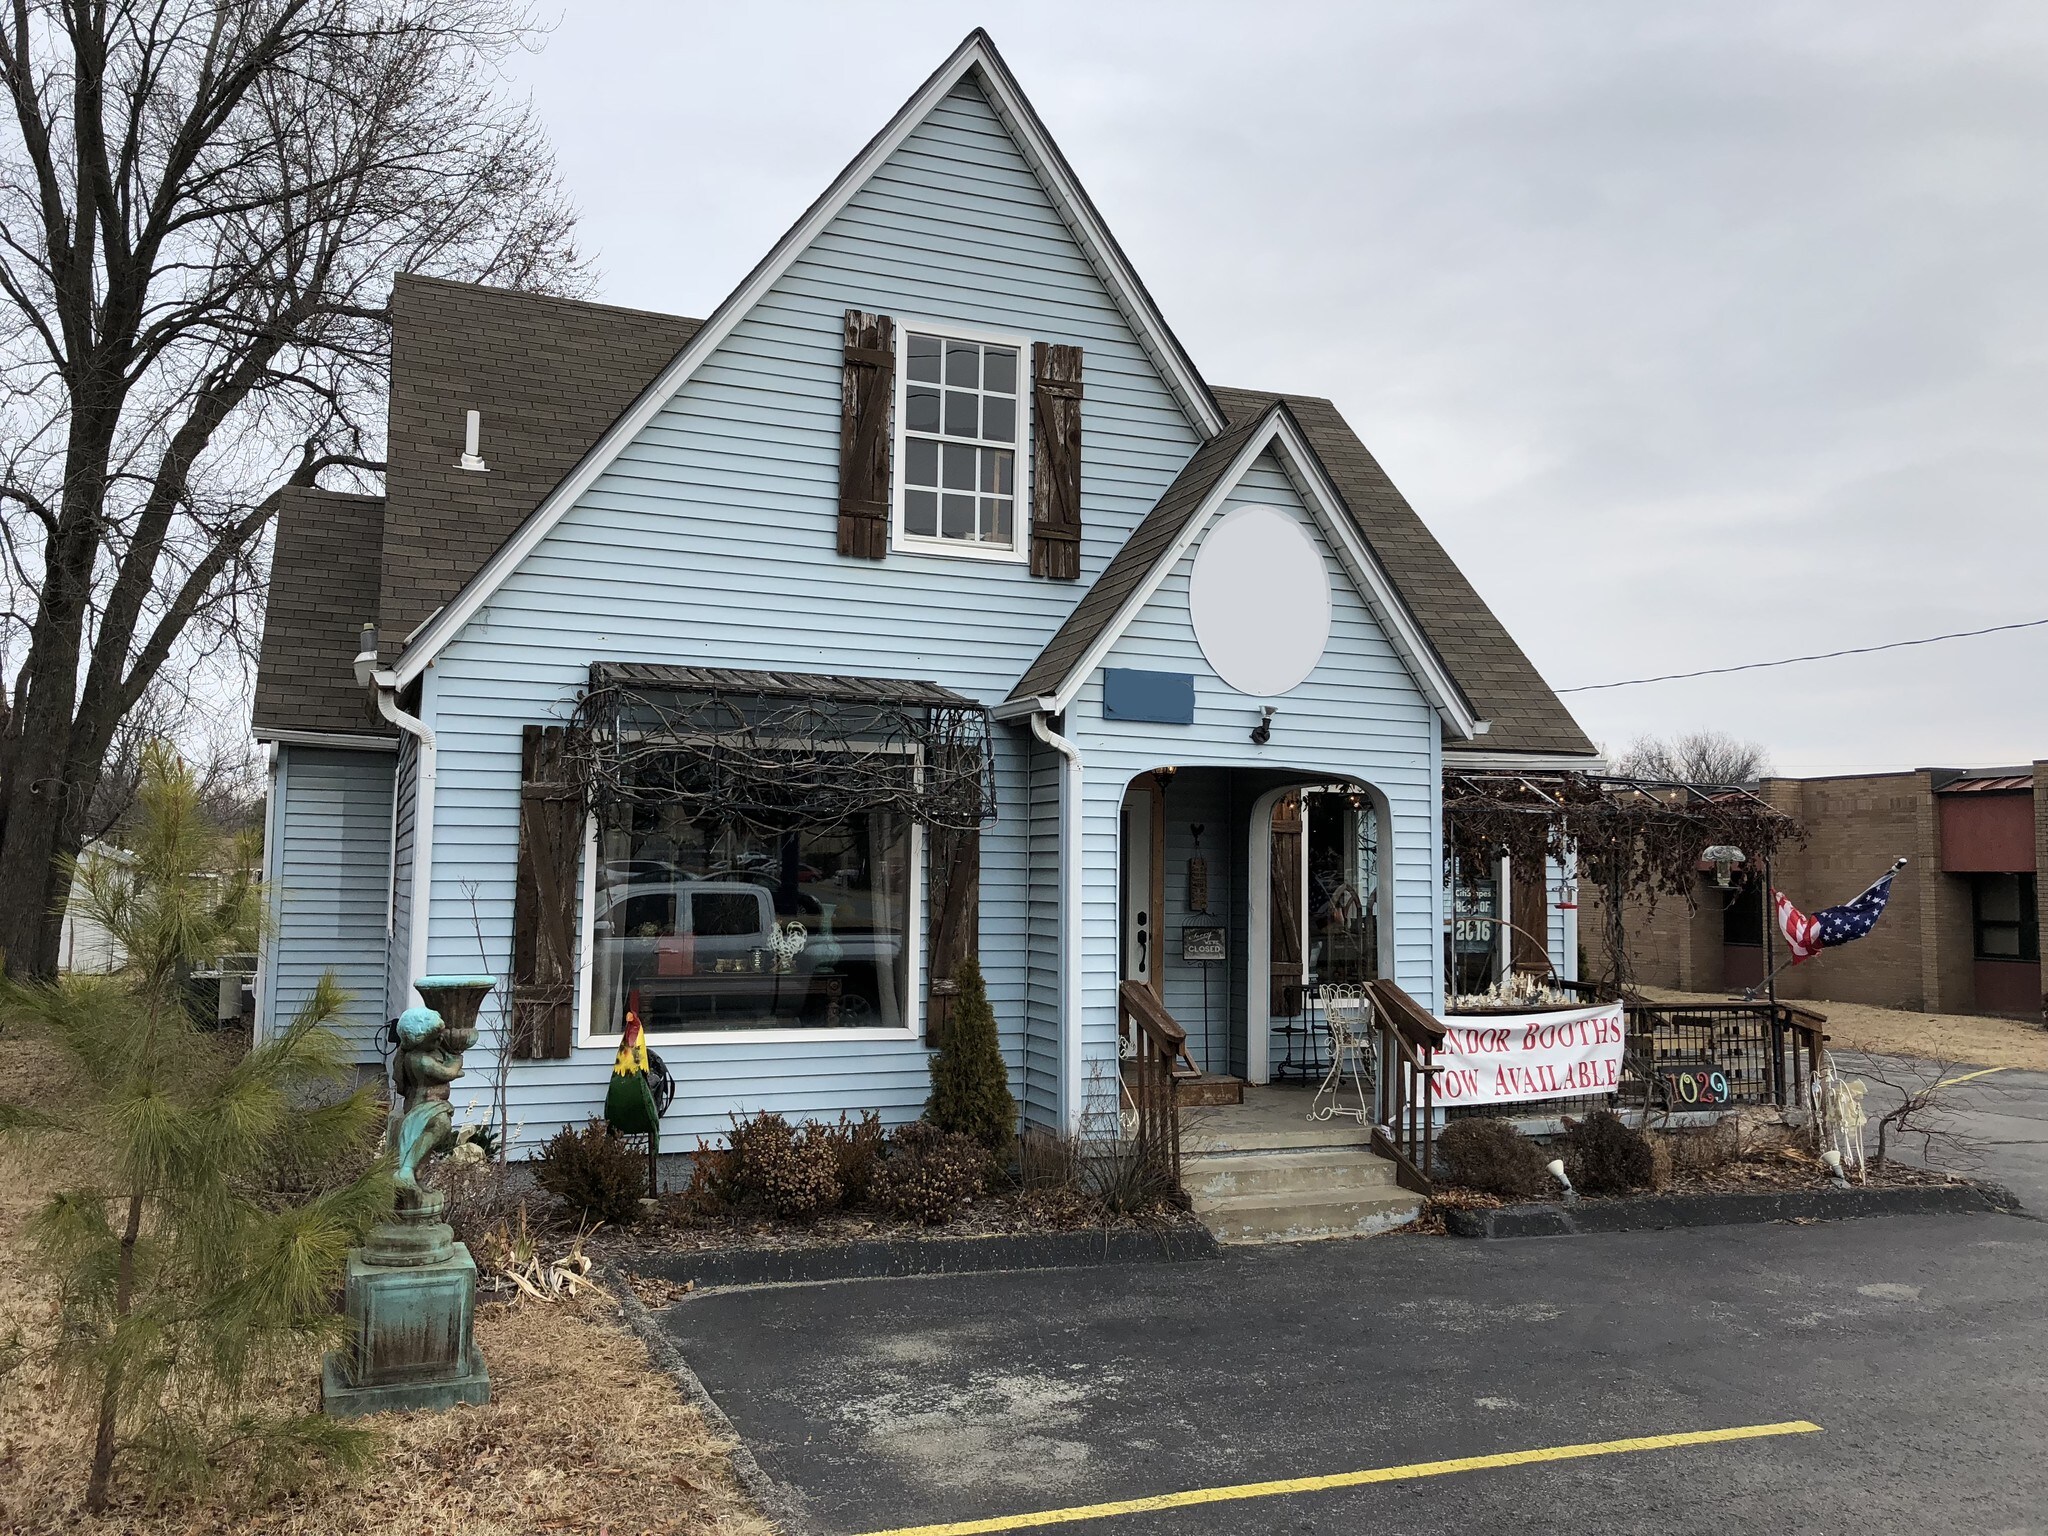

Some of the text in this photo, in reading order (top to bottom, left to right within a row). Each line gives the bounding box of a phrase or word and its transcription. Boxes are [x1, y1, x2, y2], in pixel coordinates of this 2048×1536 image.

[1480, 901, 1491, 913] OF
[1456, 920, 1490, 941] 2016
[1188, 945, 1221, 953] CLOSED
[1419, 1015, 1622, 1056] NDOR BOOTHS
[1494, 1058, 1618, 1097] AVAILABLE
[1665, 1072, 1728, 1104] 1029
